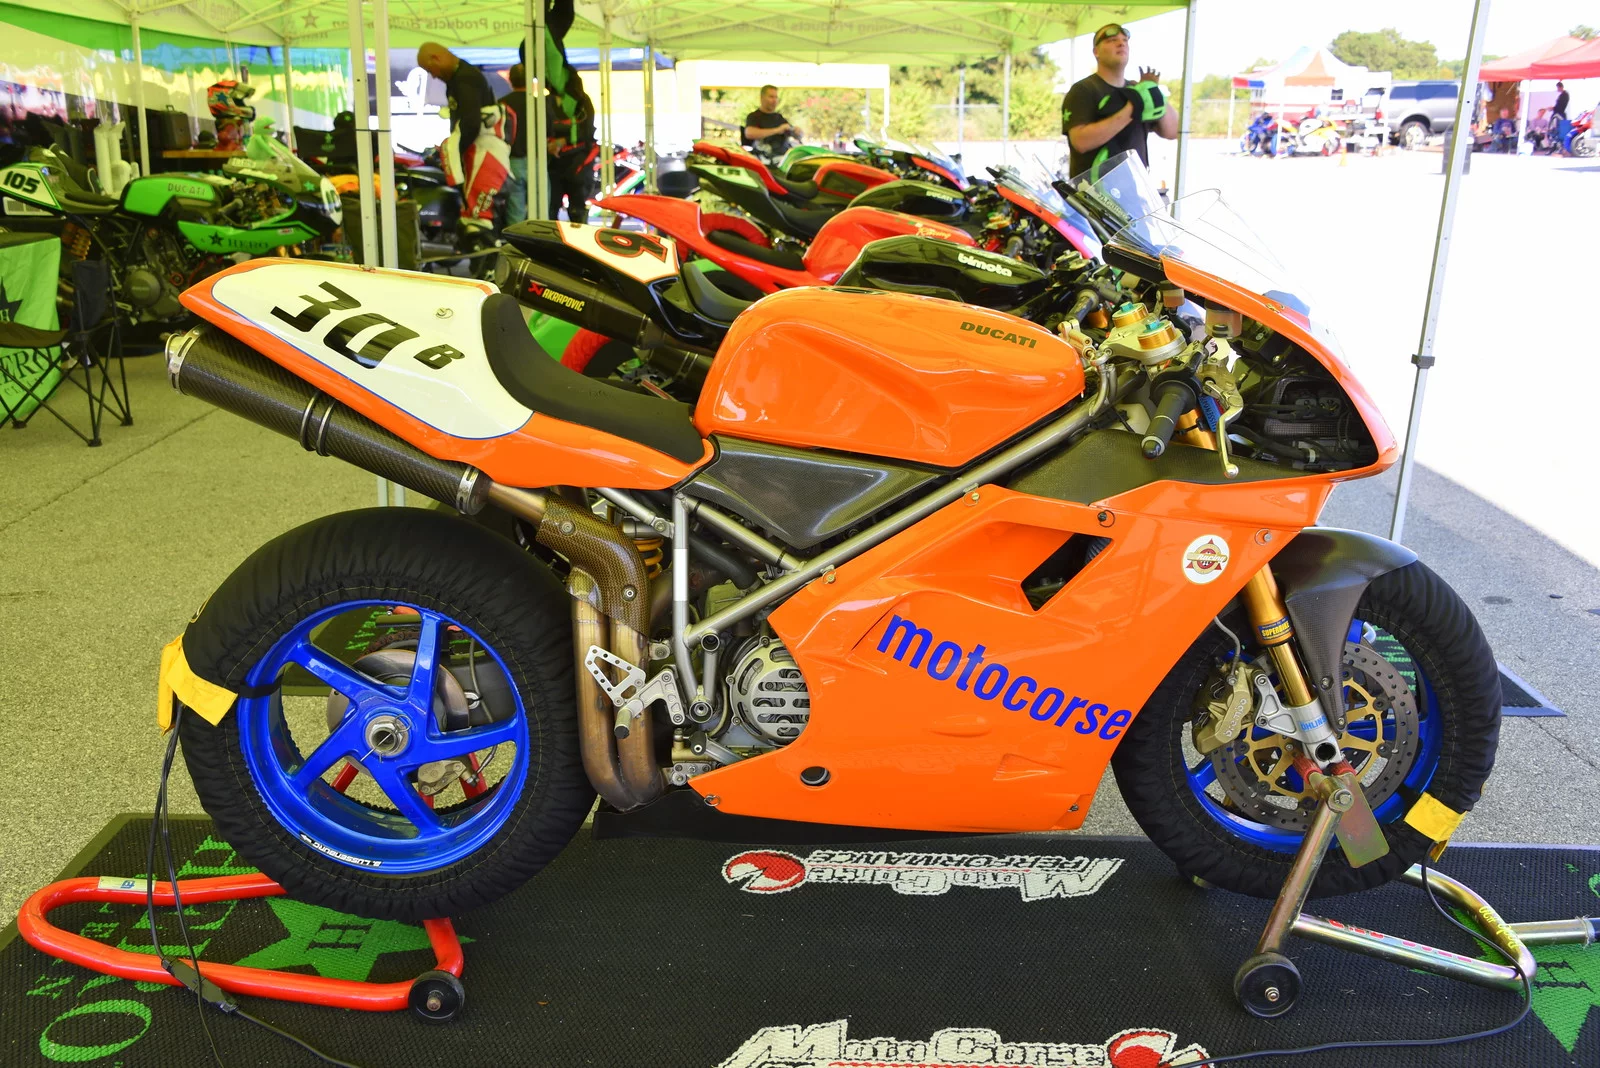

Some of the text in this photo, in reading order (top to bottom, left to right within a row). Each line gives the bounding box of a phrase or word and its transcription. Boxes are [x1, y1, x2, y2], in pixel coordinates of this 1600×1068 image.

[3, 170, 41, 194] 105
[168, 183, 206, 196] DUCATI
[957, 252, 1013, 278] bimota
[270, 281, 465, 370] 30 B
[960, 321, 1037, 349] DUCATI
[1261, 621, 1291, 638] SUPERBIKE
[876, 614, 1132, 740] motocorse
[808, 849, 1092, 871] PERFORMANCE
[717, 1018, 1107, 1068] Moto Corse
